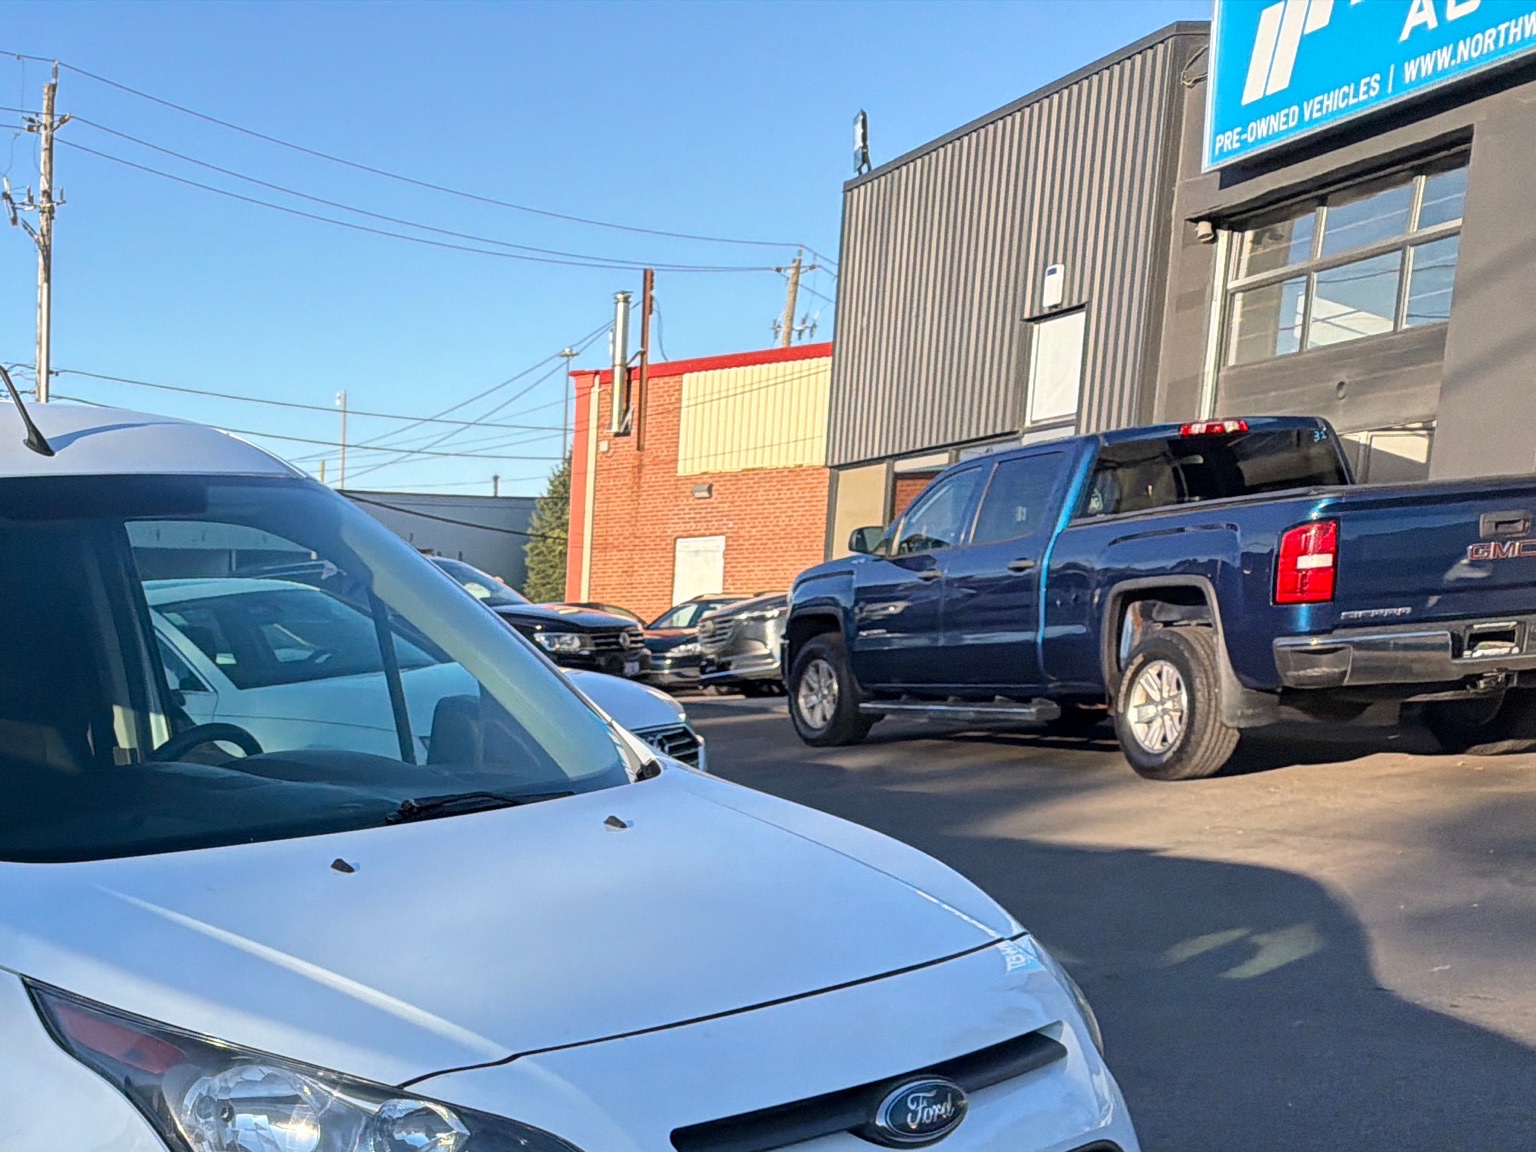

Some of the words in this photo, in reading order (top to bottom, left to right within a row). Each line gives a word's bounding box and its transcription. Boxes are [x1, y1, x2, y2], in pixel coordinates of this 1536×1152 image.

[1215, 104, 1300, 155] PRE-OWNED
[1303, 72, 1381, 122] VEHICLES
[906, 1089, 955, 1130] Ford
